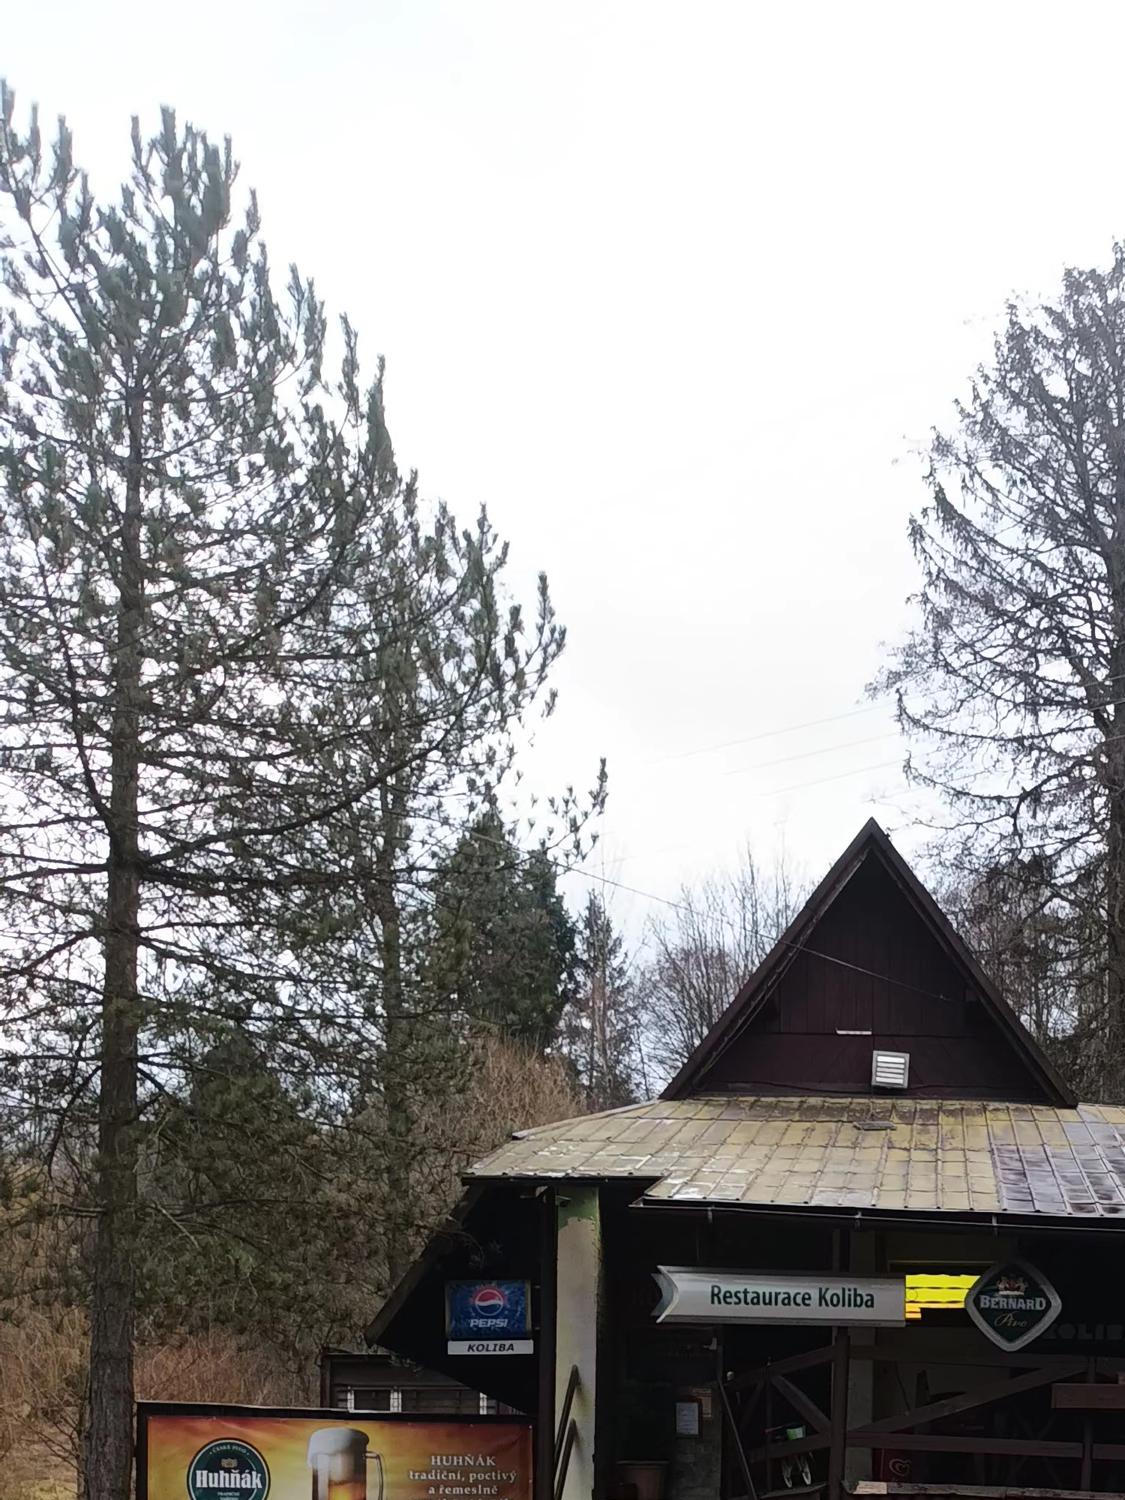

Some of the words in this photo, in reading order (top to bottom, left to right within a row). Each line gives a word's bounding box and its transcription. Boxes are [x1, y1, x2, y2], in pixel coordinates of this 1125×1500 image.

[710, 1284, 812, 1307] Restaurace
[818, 1286, 875, 1308] Koliba
[979, 1294, 1047, 1311] BERNARD
[469, 1318, 509, 1328] PEPSI
[467, 1343, 515, 1353] KOLIBA
[431, 1454, 496, 1466] HUHŇÁK
[195, 1469, 263, 1489] Huhňák
[409, 1470, 465, 1482] tradiční,
[469, 1470, 517, 1483] poctivý
[428, 1487, 435, 1495] a
